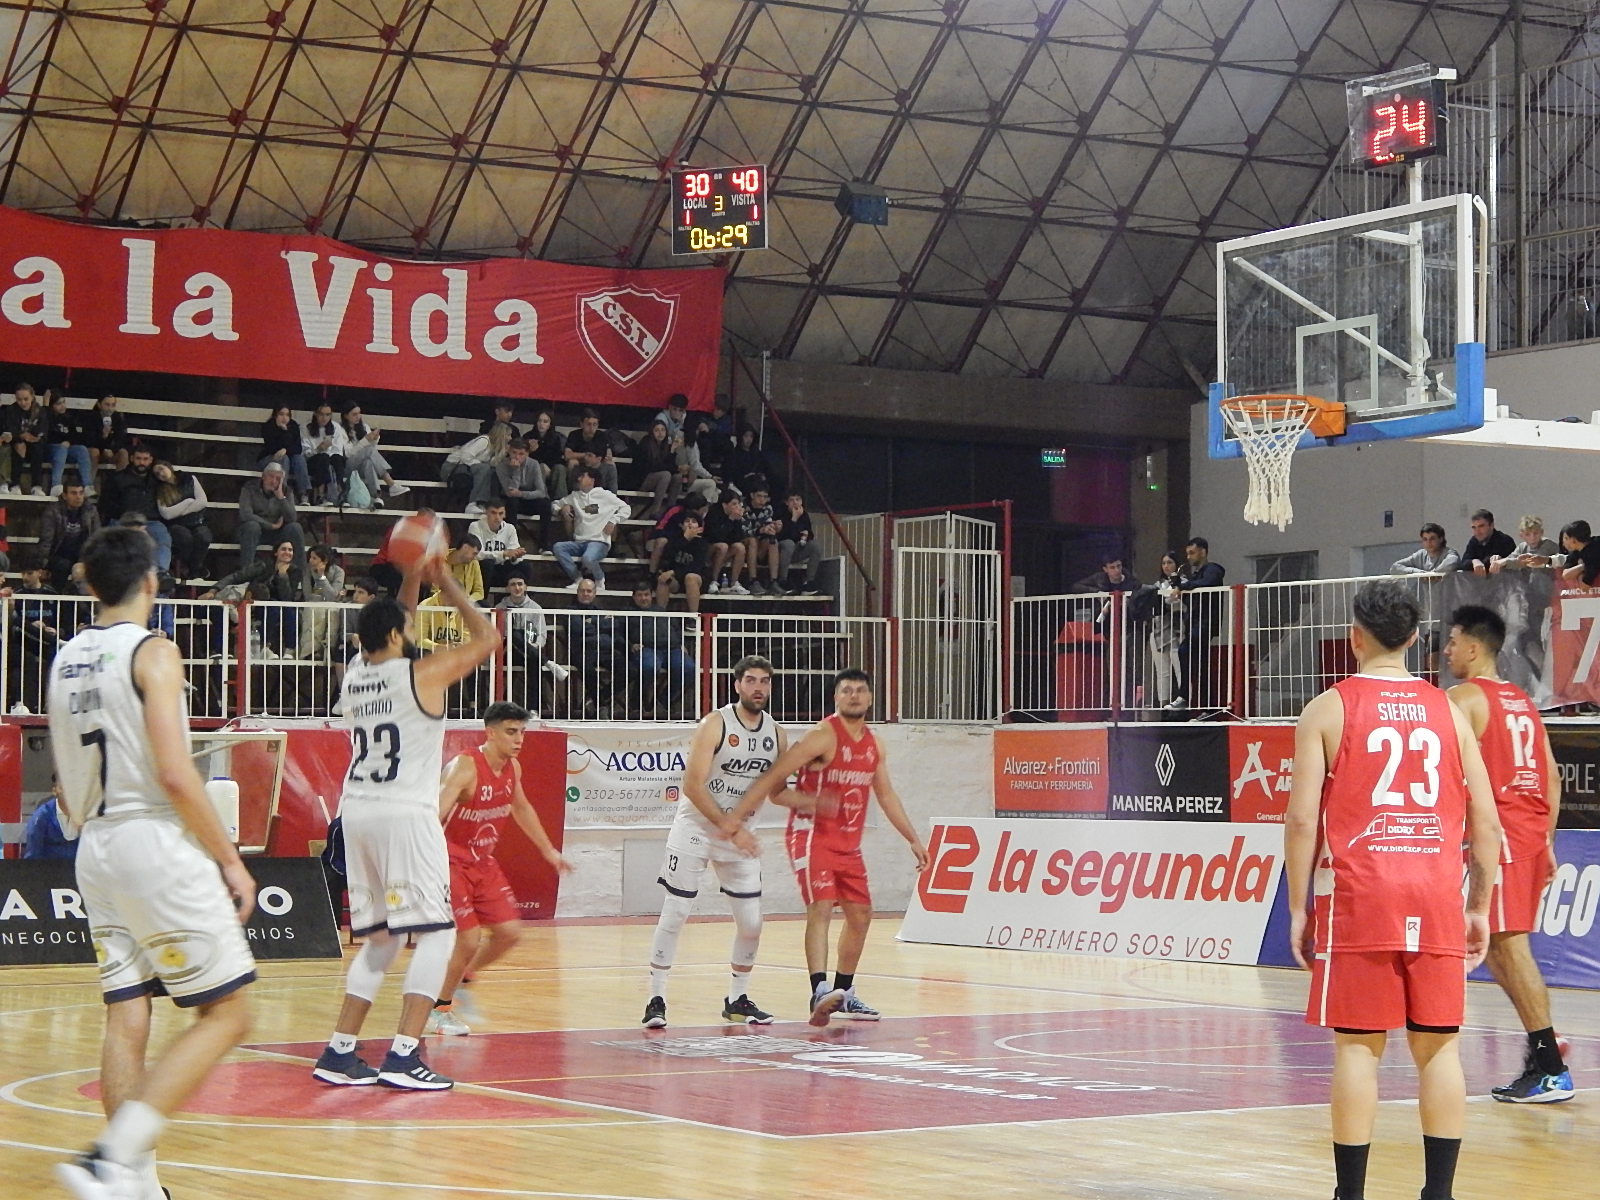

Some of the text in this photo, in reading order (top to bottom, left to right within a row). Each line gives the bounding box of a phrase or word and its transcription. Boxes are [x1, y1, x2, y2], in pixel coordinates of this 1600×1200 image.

[1374, 100, 1426, 162] 24
[685, 173, 710, 197] 30
[732, 169, 759, 193] 40
[683, 197, 708, 210] LOCAL
[714, 195, 723, 211] 3
[731, 193, 756, 206] VISITA
[690, 224, 748, 250] 06:29
[0, 238, 545, 365] a la Vida
[1043, 455, 1065, 463] SALIDA
[1377, 702, 1427, 723] SIERRA
[748, 737, 757, 752] 13
[1505, 713, 1536, 769] 12
[349, 723, 401, 783] 23
[606, 751, 687, 772] ACQUA
[80, 728, 107, 817] 7
[1367, 726, 1441, 808] 23
[1010, 781, 1043, 790] FARMACIA
[1557, 763, 1595, 793] PPLE
[481, 785, 493, 802] 33
[584, 789, 661, 800] 2302-567774
[1112, 795, 1223, 814] MANERA PEREZ
[1367, 844, 1441, 854] WWW.DIDEXGP.COM
[669, 854, 678, 872] 13
[988, 831, 1275, 914] la segunda
[2, 931, 86, 944] NEGOCI
[985, 926, 1232, 960] LO PRIMERO SOS VOS
